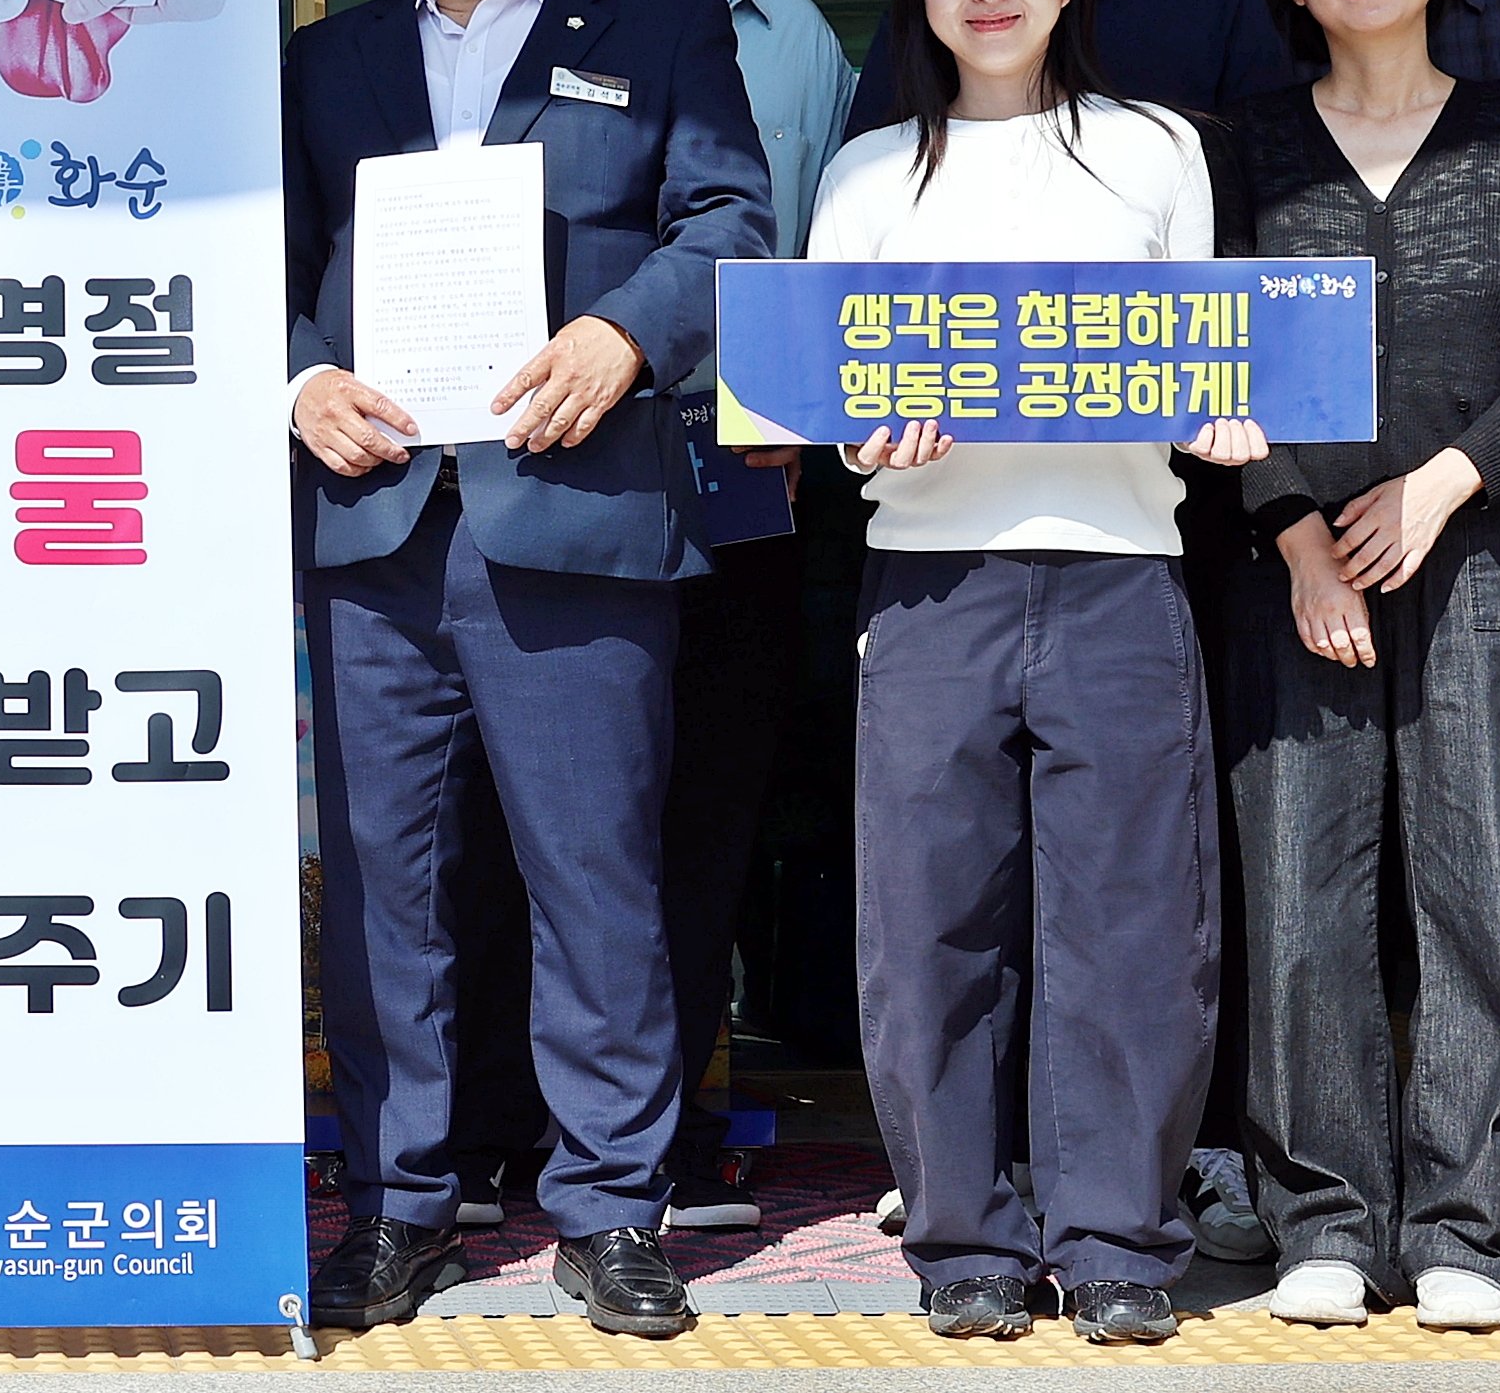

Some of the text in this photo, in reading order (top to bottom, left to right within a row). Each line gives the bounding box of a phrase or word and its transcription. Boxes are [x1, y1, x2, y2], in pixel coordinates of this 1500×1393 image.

[48, 140, 168, 220] 화순
[1320, 273, 1357, 298] 화순
[838, 288, 1250, 350] 생각은 청렴하게!
[838, 359, 1250, 418] 행동은 공정하게!
[113, 1251, 194, 1276] Council
